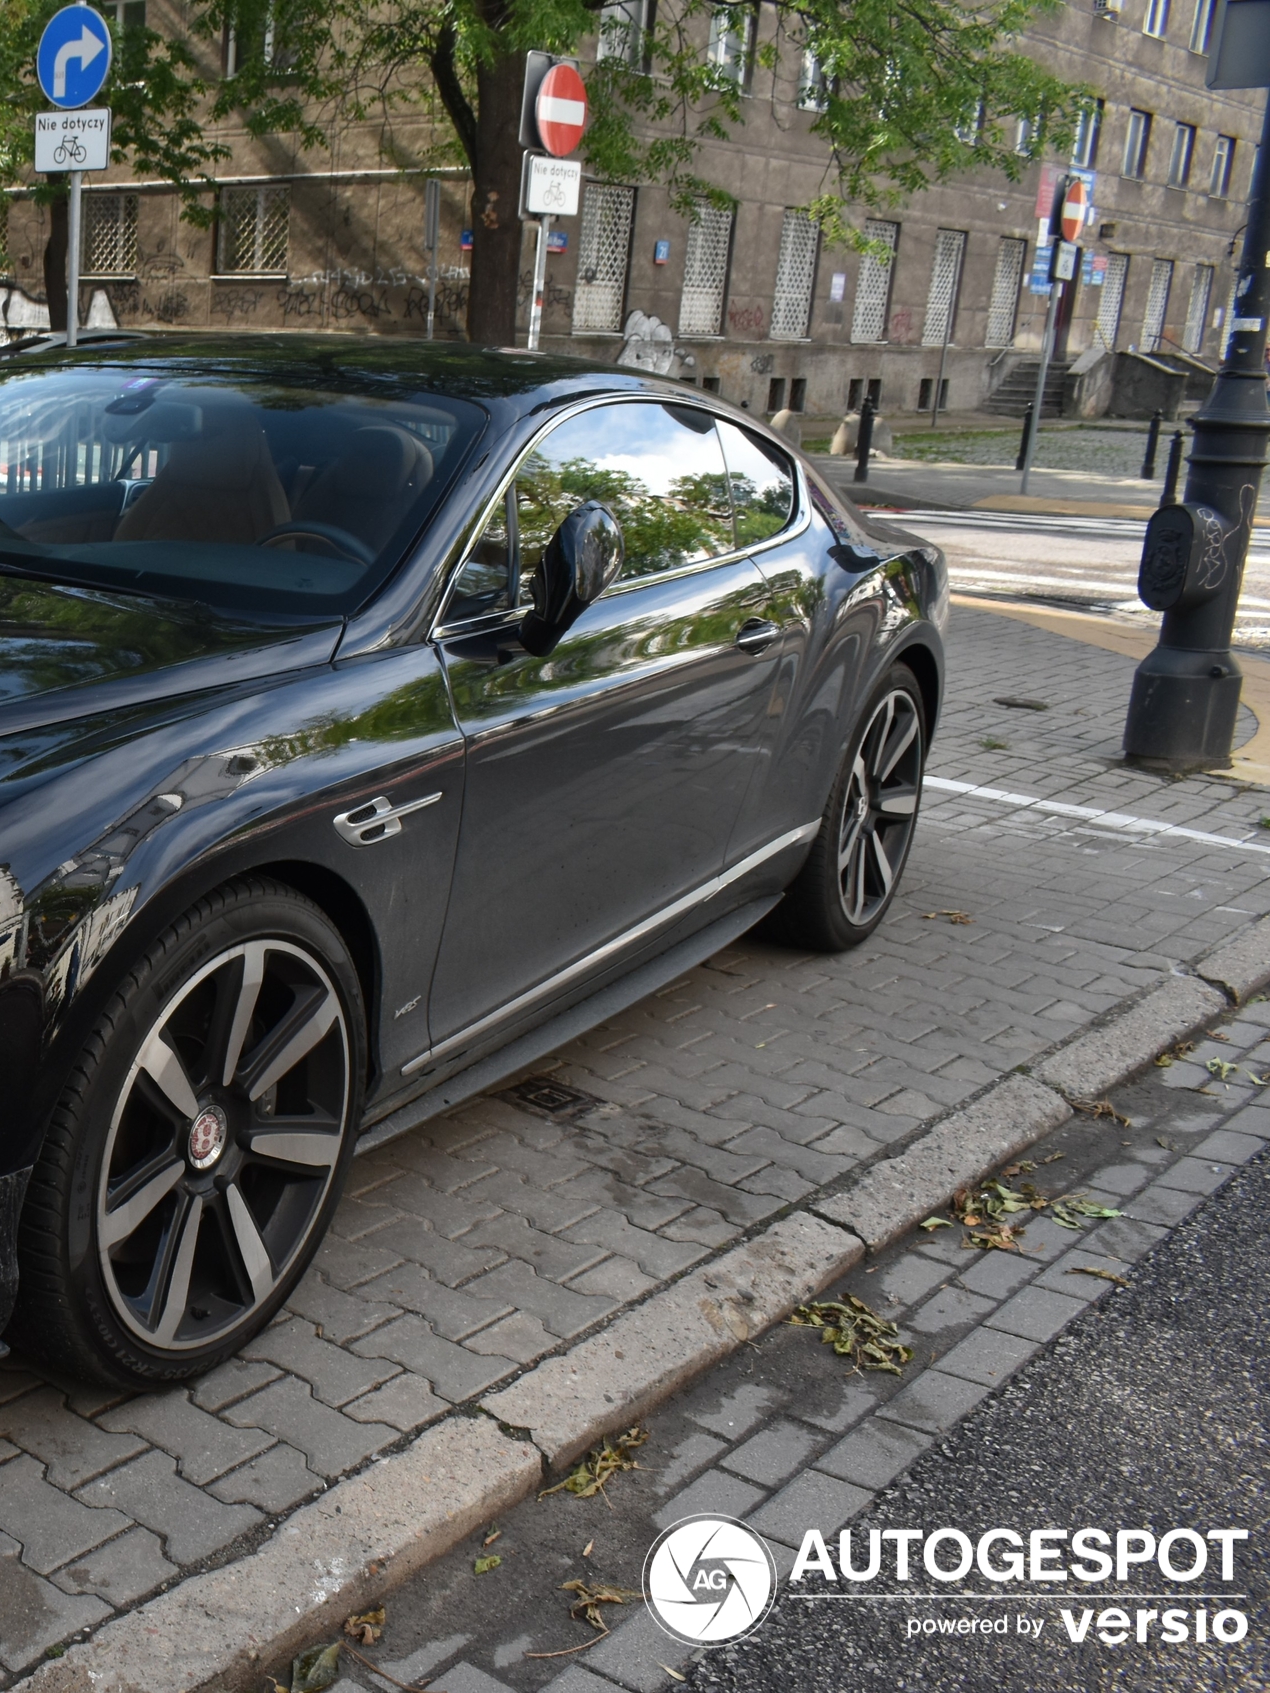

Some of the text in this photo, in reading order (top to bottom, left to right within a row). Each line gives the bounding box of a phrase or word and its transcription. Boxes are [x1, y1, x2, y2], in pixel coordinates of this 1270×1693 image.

[38, 116, 105, 132] Nie dotyczy
[534, 162, 578, 181] Nie dotyczy
